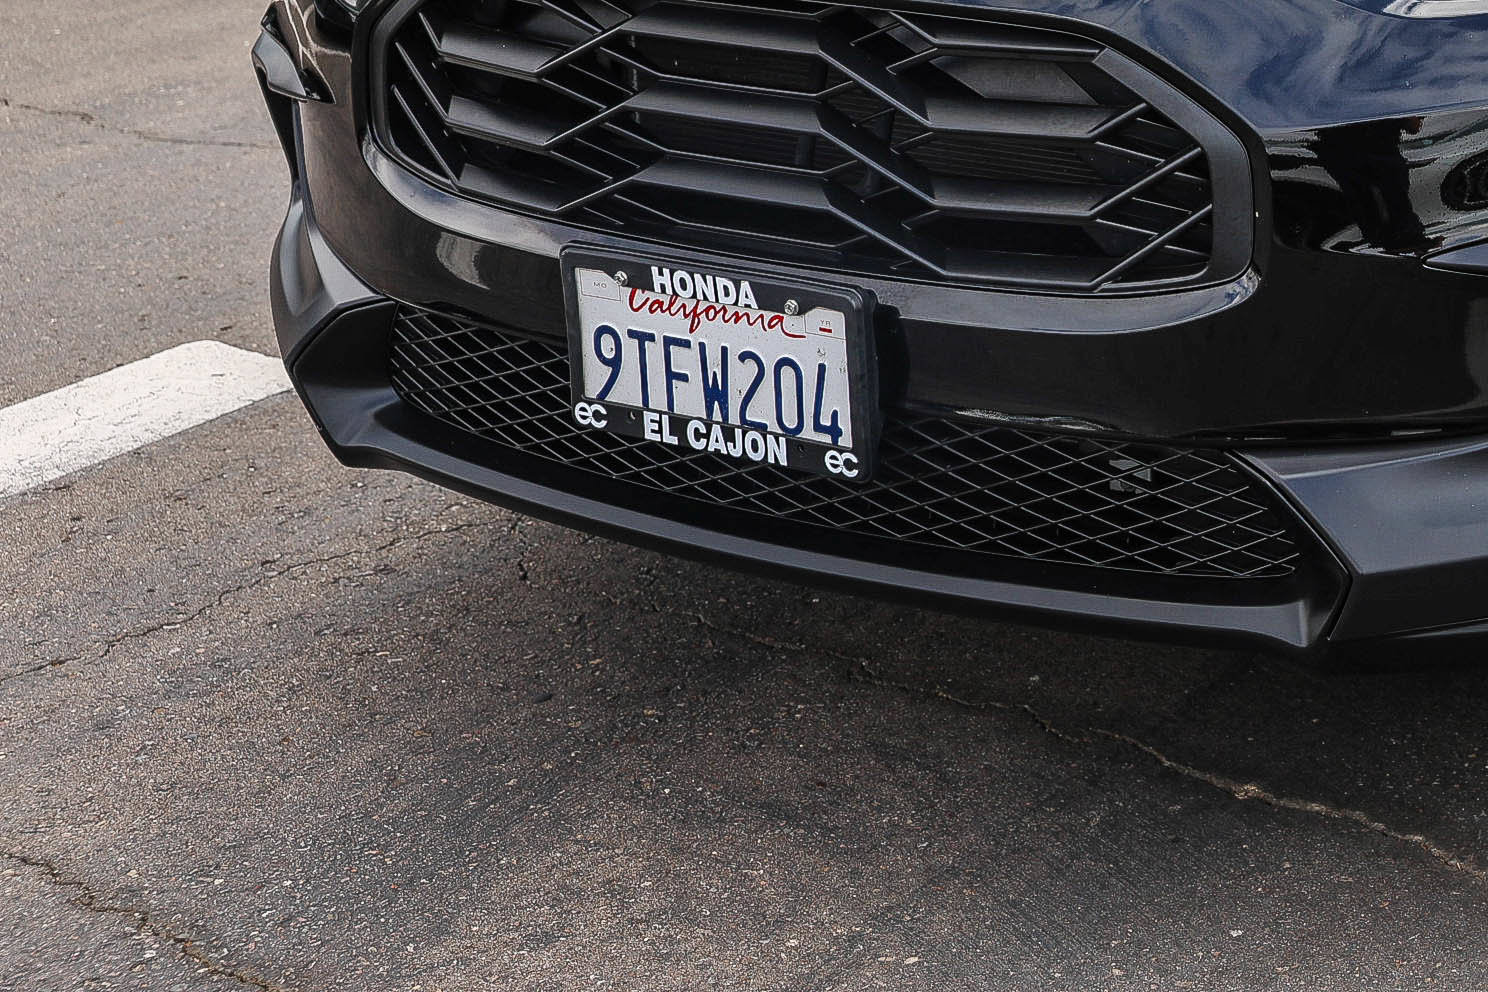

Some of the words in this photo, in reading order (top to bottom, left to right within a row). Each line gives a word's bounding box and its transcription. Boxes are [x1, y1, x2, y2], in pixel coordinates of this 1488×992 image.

[628, 287, 806, 339] California
[650, 265, 759, 309] HONDA
[593, 324, 844, 446] 9TFW204
[643, 410, 678, 446] EL
[686, 419, 788, 467] CAJON
